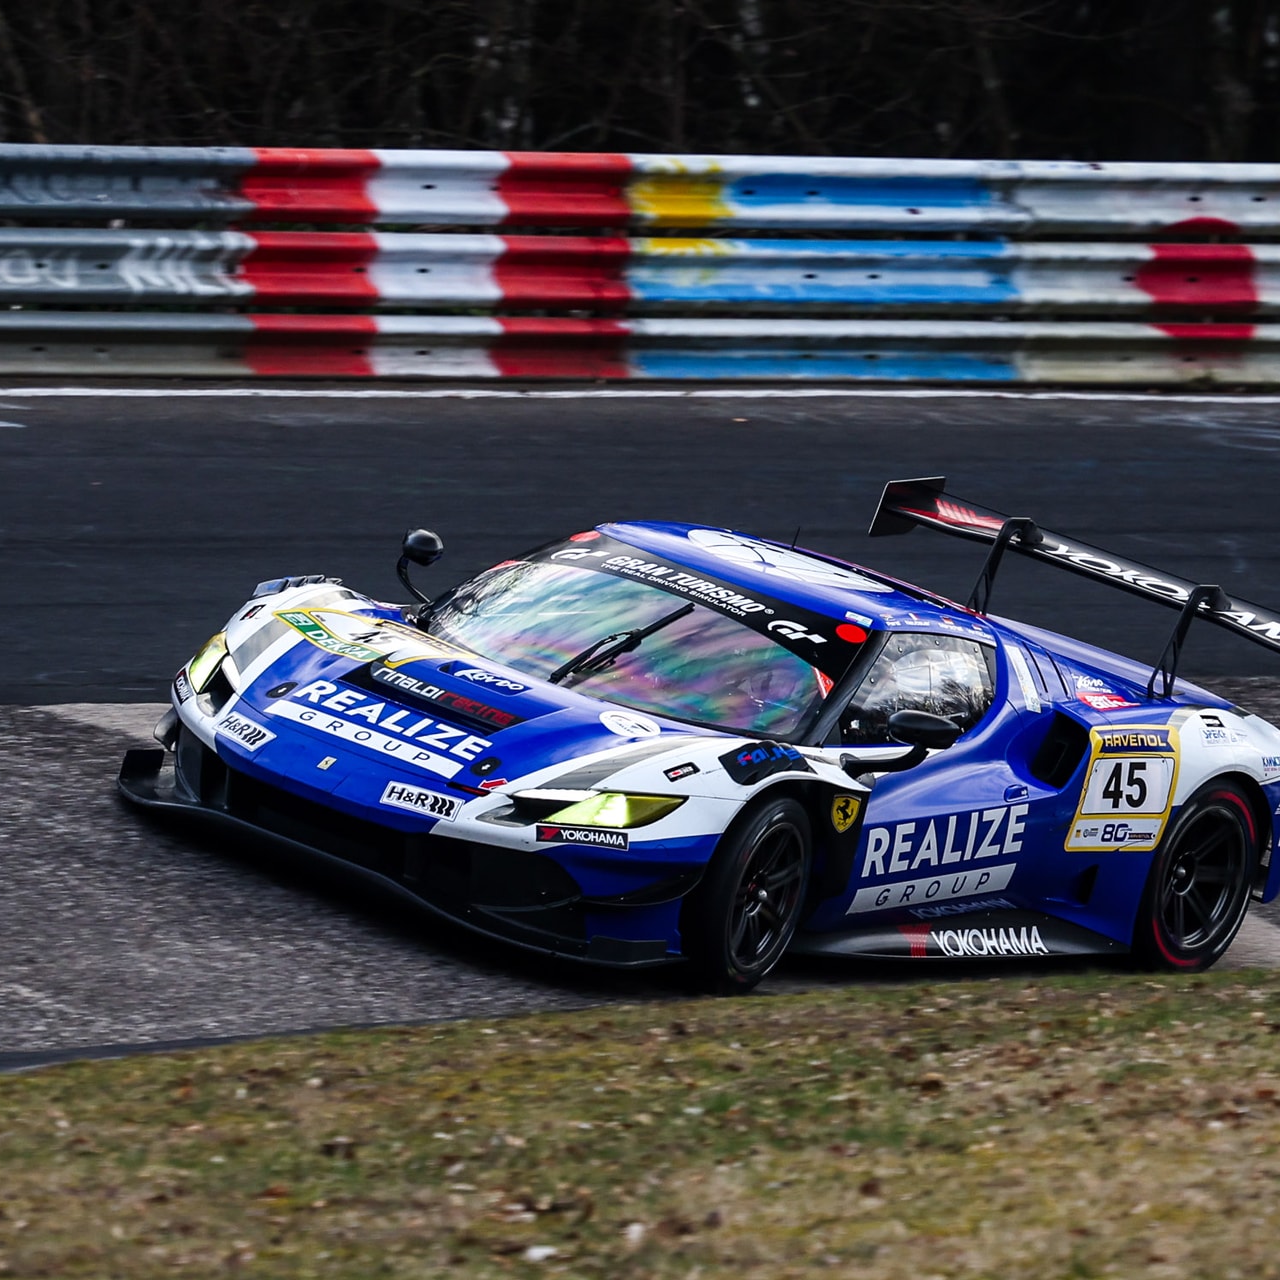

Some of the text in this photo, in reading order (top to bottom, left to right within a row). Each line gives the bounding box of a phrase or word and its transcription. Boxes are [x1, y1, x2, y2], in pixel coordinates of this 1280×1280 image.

[605, 556, 668, 578] GRAN
[600, 563, 747, 617] THE REAL DRIVING SIMULATOR
[306, 630, 370, 659] DEKRA
[293, 679, 493, 761] REALIZE
[299, 711, 431, 762] GROUP
[1105, 734, 1167, 747] RAVENOL
[1102, 761, 1148, 809] 45
[560, 829, 626, 847] YOKOHAMA
[861, 803, 1029, 878] REALIZE
[875, 871, 991, 907] GROUP
[931, 925, 1049, 957] YOKOHAMA
